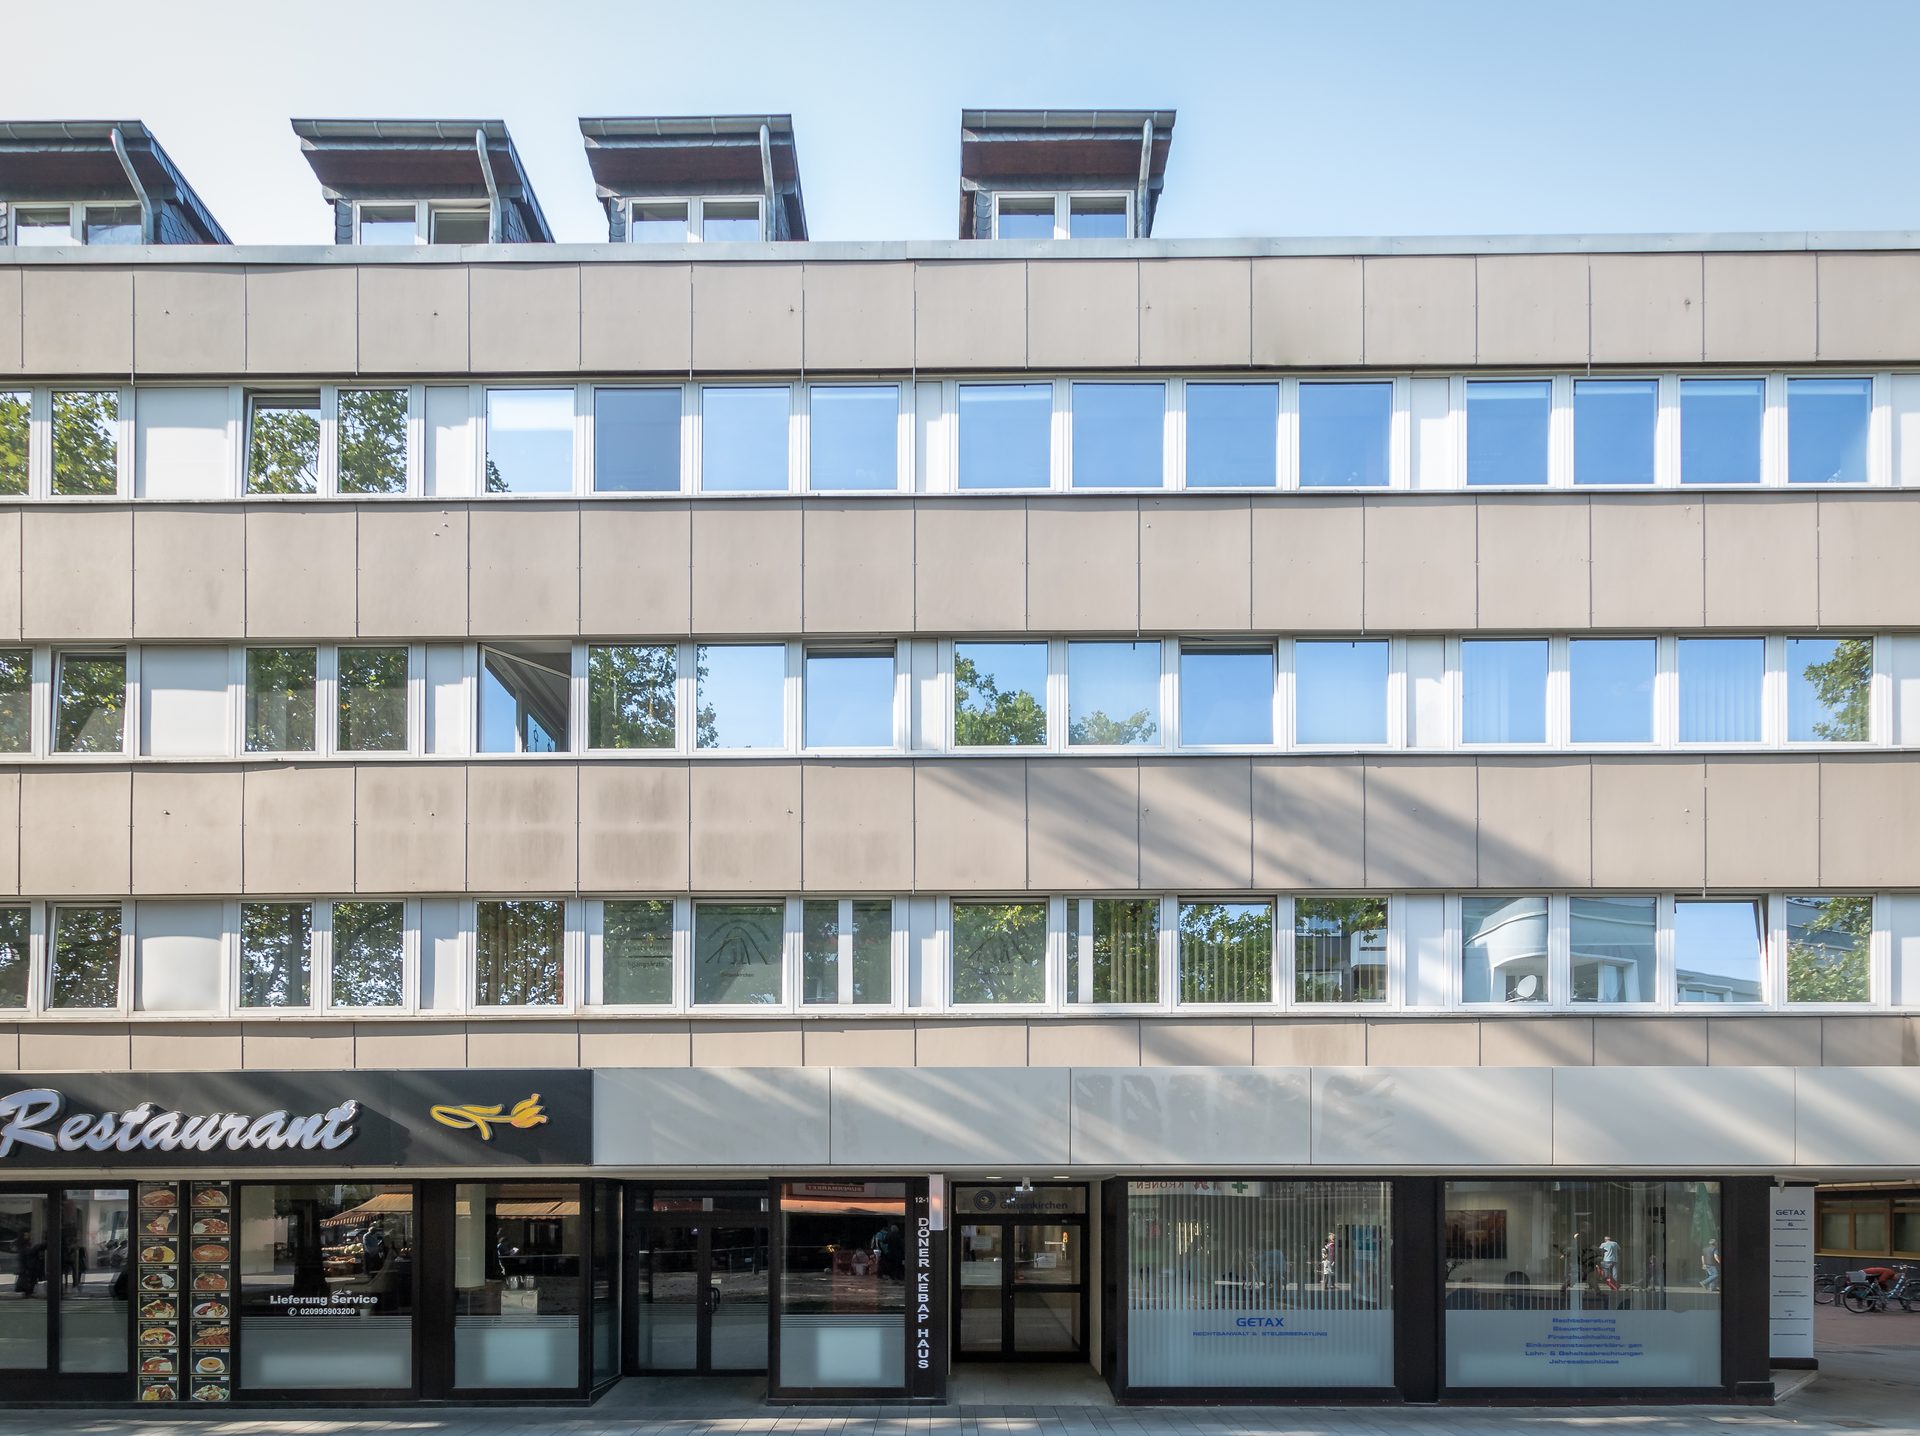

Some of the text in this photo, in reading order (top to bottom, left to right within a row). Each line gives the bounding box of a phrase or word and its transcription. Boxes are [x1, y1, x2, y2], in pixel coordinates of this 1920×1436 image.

[0, 1088, 360, 1157] Restaurant
[269, 1295, 378, 1306] Lieferung Service
[917, 1217, 931, 1369] DÖNER KEBAP HAUS
[1236, 1317, 1284, 1327] GETAX
